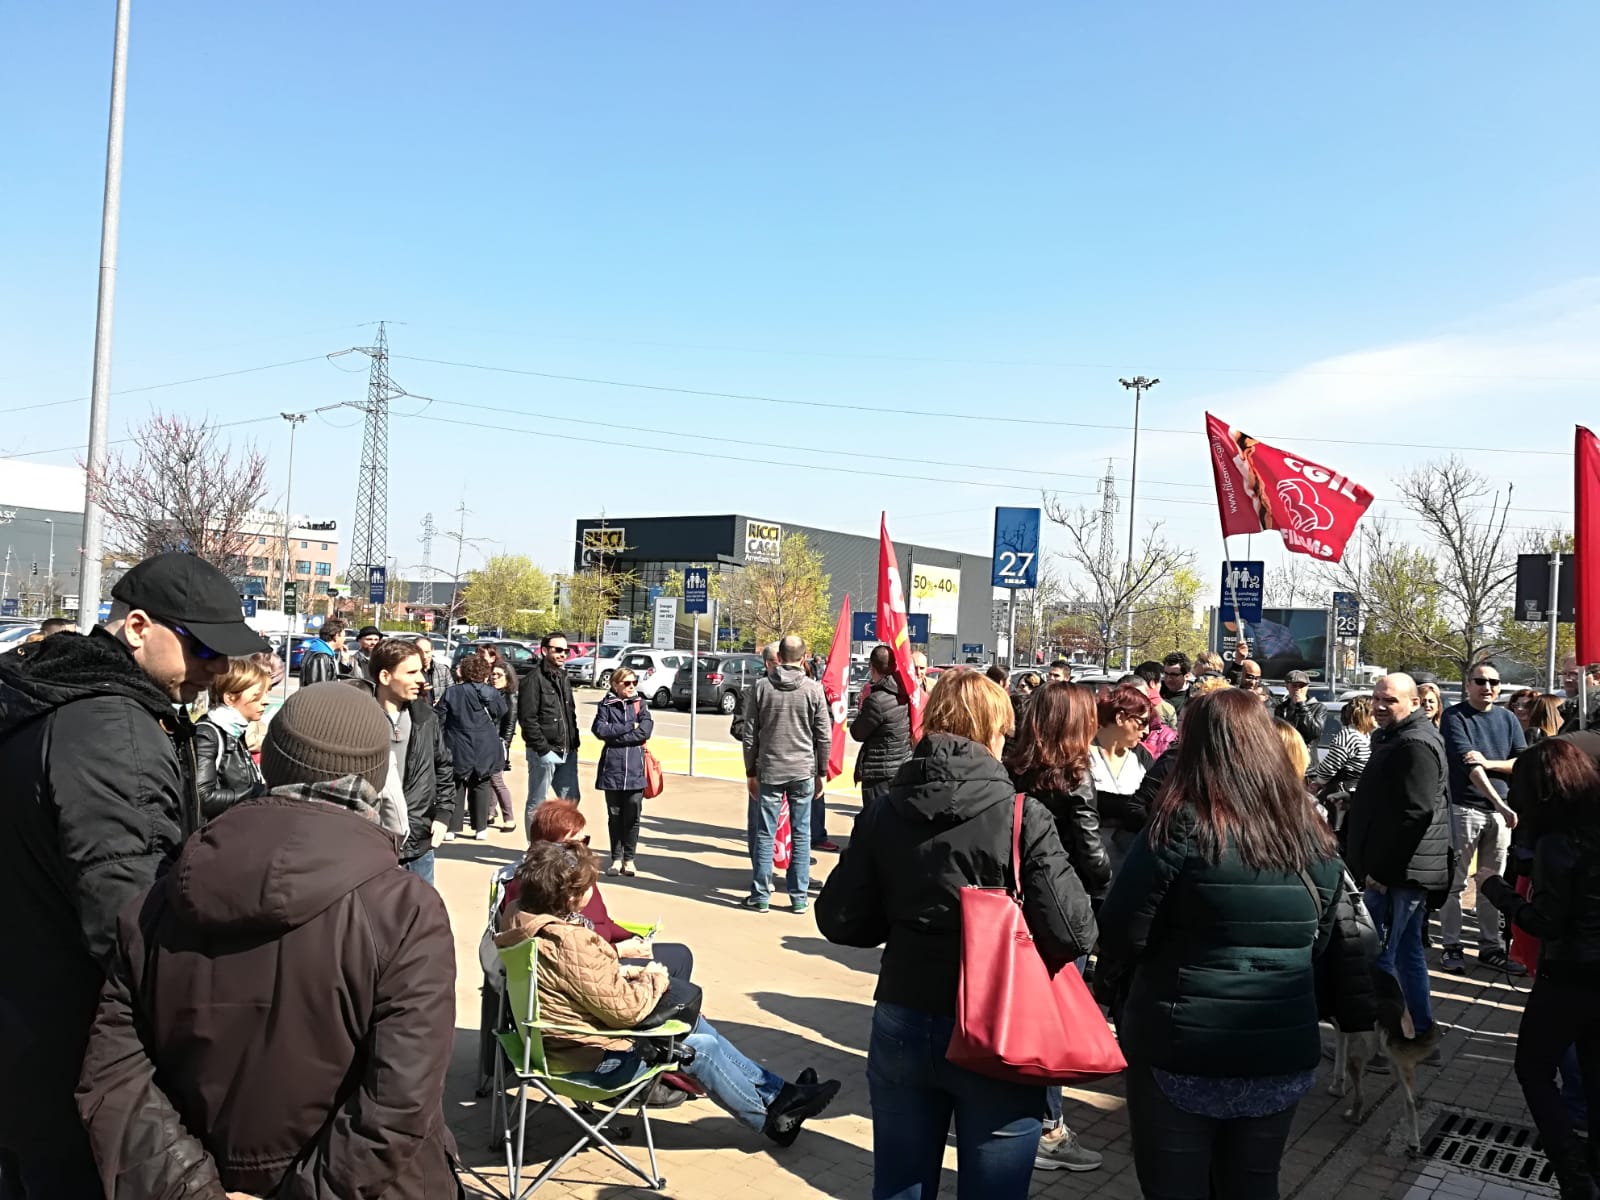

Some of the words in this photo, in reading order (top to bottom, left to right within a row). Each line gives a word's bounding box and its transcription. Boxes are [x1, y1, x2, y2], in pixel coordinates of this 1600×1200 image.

[1283, 456, 1358, 502] CGIL
[748, 523, 779, 541] RICCI
[998, 551, 1035, 577] 27
[1337, 616, 1357, 631] 28
